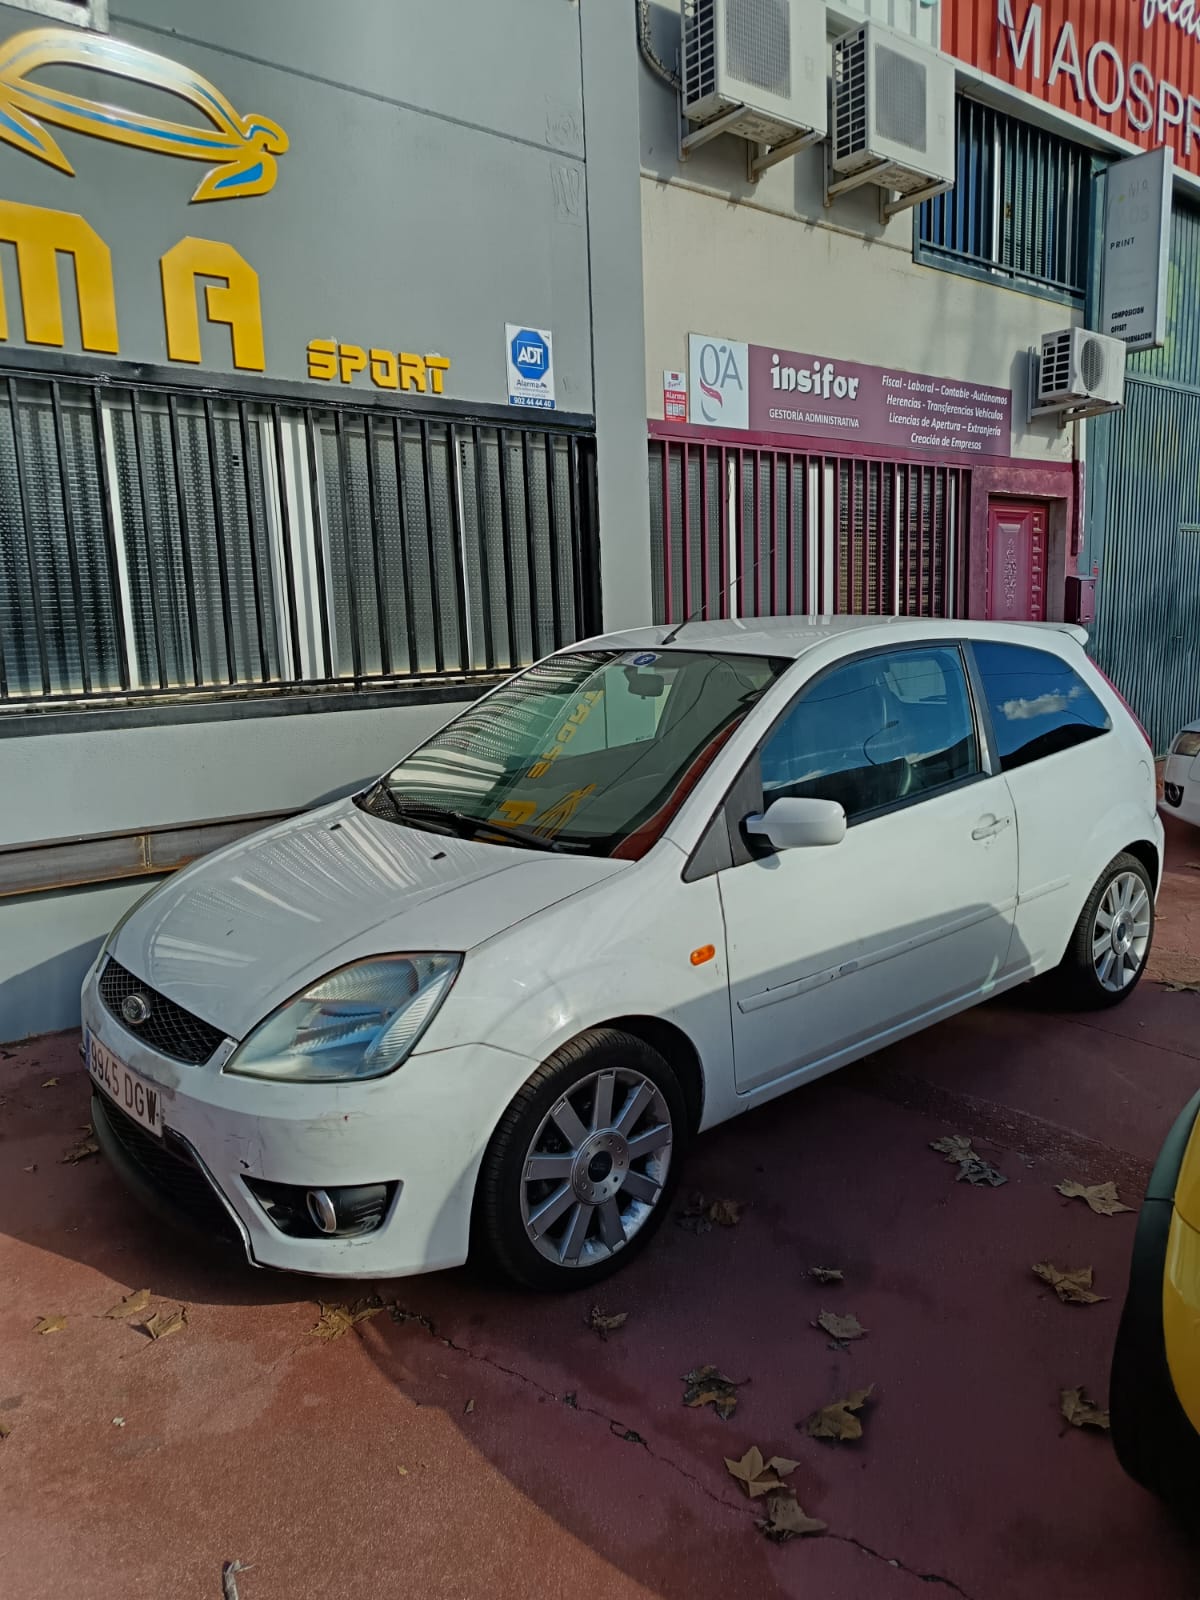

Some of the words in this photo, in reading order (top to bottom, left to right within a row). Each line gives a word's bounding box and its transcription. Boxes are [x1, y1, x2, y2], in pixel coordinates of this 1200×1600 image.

[1110, 237, 1135, 250] PRINT
[1111, 306, 1145, 320] COMPOSICION
[1110, 323, 1127, 333] OFFSET
[518, 345, 543, 365] ADT
[307, 338, 450, 394] SPORT
[516, 380, 539, 389] Alarma
[770, 353, 860, 400] insifor
[882, 375, 903, 388] Fiscal
[908, 379, 935, 393] Laboral
[940, 385, 970, 399] Contable
[513, 396, 525, 405] 902
[886, 394, 922, 409] Herencias
[927, 400, 974, 416] Transferencias
[975, 407, 1004, 420] Vehículos
[769, 409, 804, 421] GESTORÍA
[805, 413, 860, 428] ADMINISTRATIVA
[888, 412, 920, 426] Licencias
[921, 416, 930, 428] de
[930, 418, 961, 431] Apertura
[910, 432, 940, 446] Creación
[941, 436, 950, 447] de
[951, 437, 982, 450] Empresas
[90, 1040, 120, 1097] 9945
[124, 1072, 158, 1127] DGW
